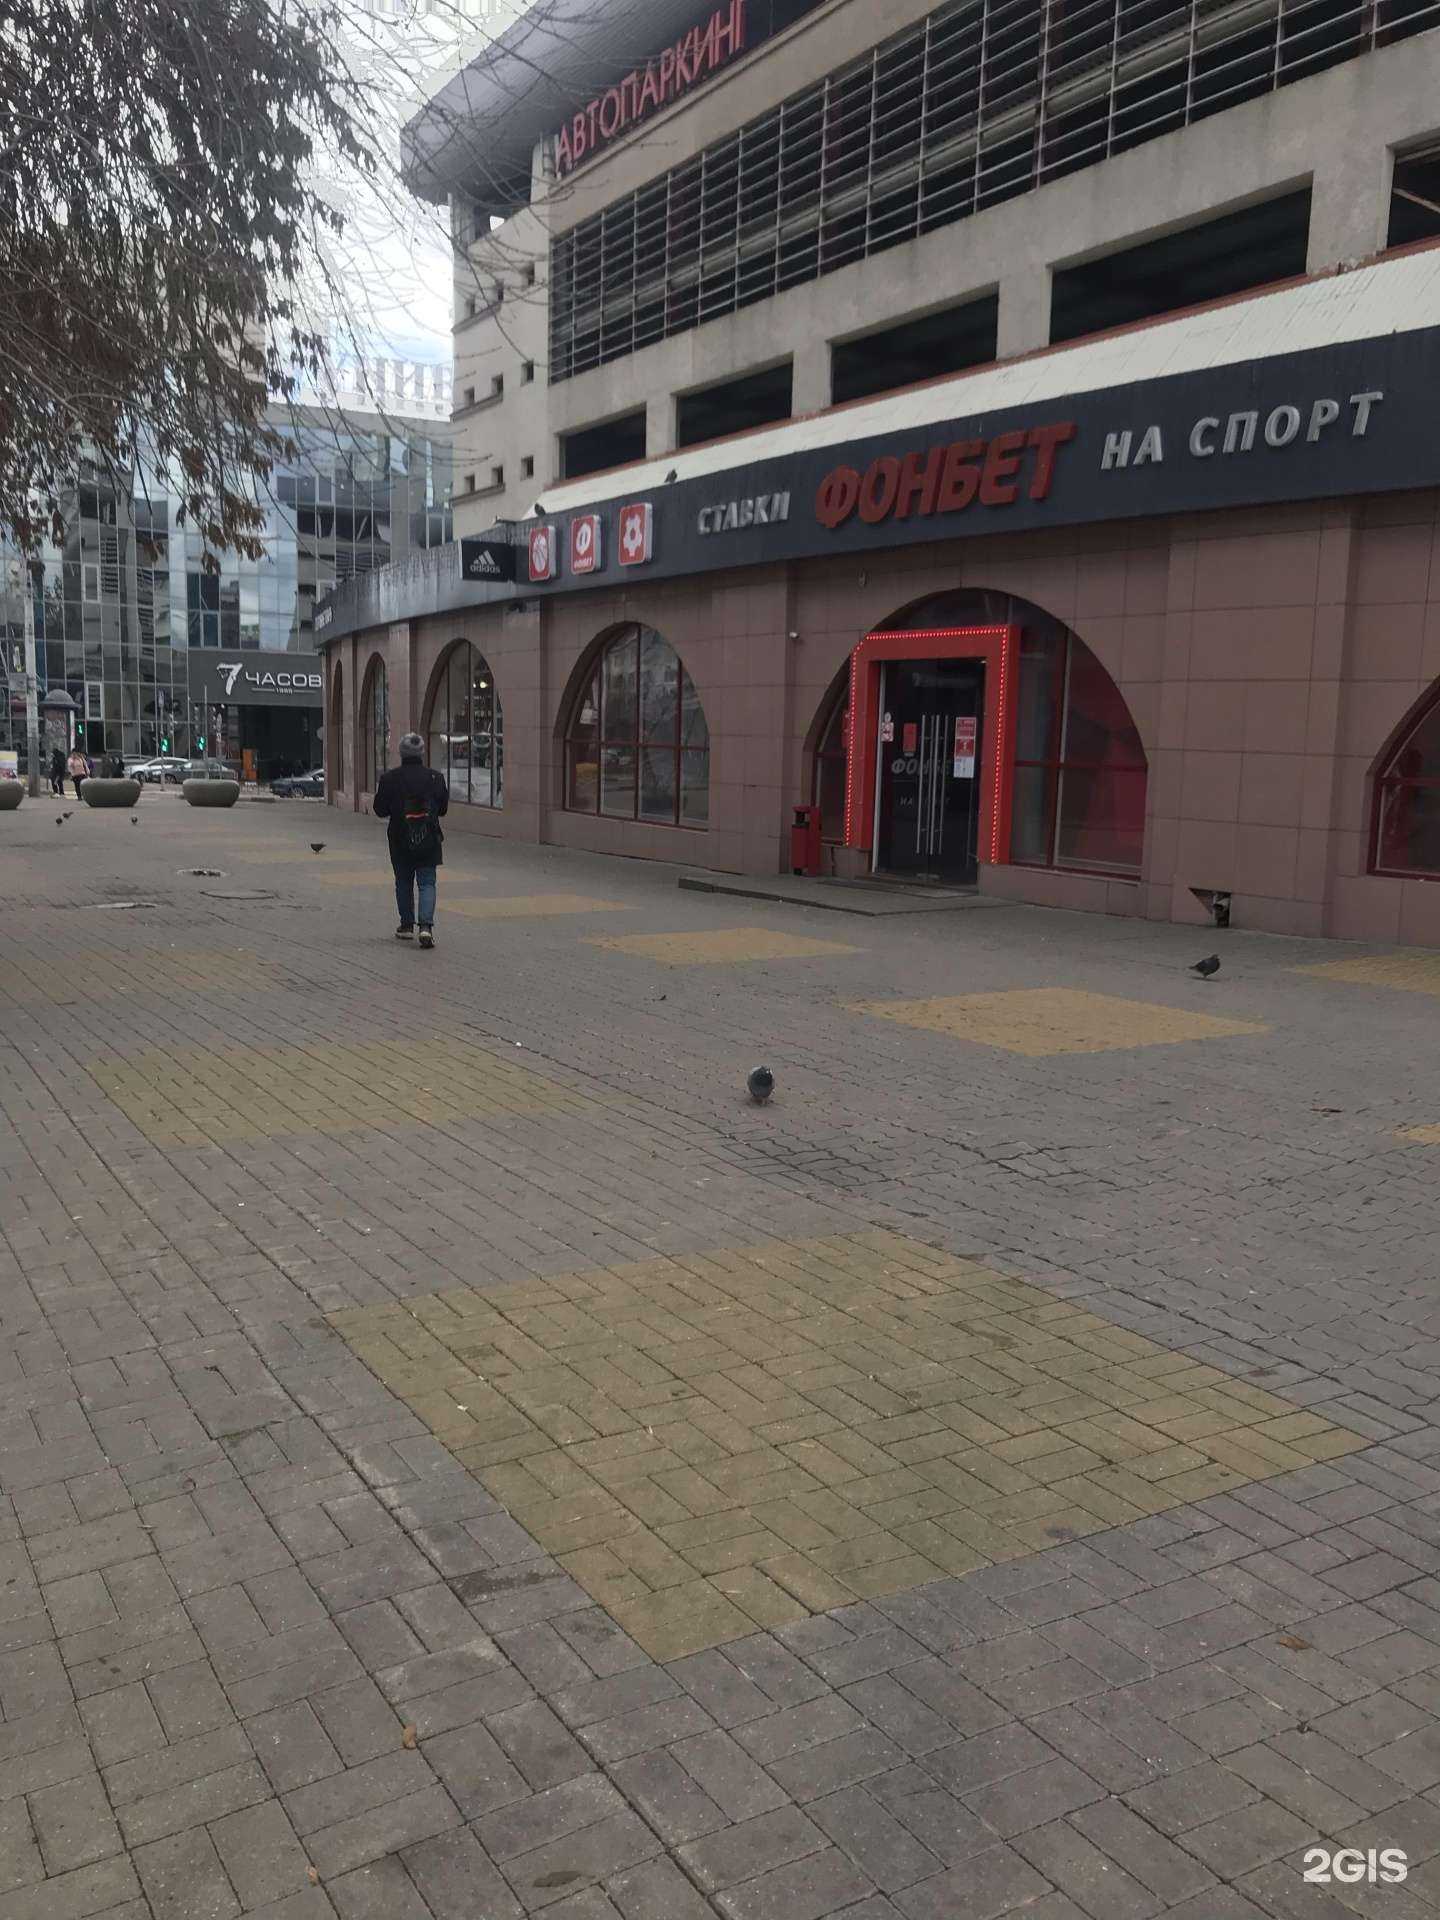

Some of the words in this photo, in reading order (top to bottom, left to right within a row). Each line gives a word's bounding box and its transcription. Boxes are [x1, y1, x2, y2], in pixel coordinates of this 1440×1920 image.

[697, 491, 791, 535] СТАВКИ
[815, 421, 1077, 529] ФОНБЕТ
[1101, 426, 1163, 470] НА
[1189, 391, 1383, 457] СПОРТ
[469, 563, 501, 574] adidas
[216, 662, 243, 696] 7
[245, 671, 322, 688] ЧАСОВ
